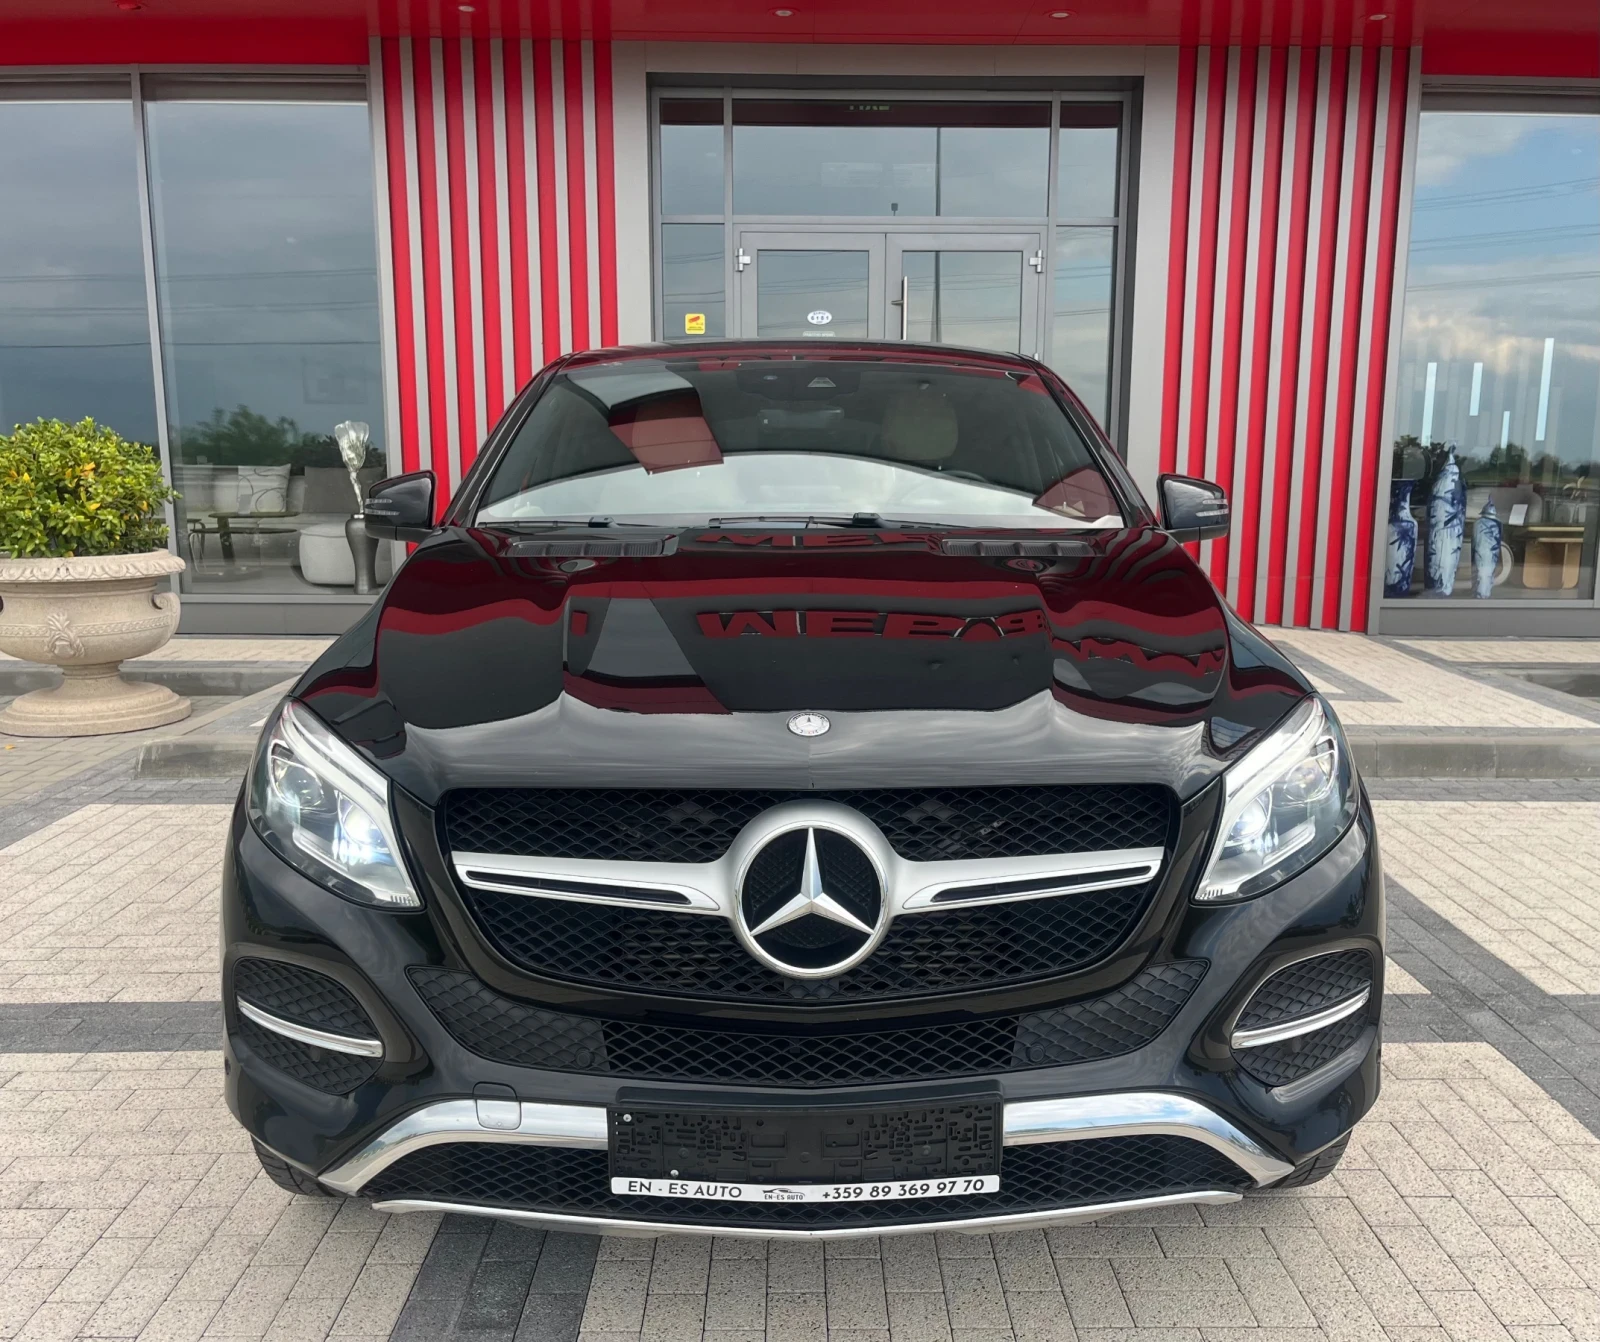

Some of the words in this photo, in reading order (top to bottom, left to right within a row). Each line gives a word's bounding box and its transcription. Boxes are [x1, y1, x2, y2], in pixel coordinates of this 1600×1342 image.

[628, 1180, 652, 1193] EN
[668, 1183, 689, 1195] ES
[693, 1185, 742, 1198] AUTO
[822, 1186, 863, 1199] +359
[869, 1185, 892, 1198] 89
[898, 1183, 930, 1196] 369
[936, 1181, 957, 1194] 97
[963, 1178, 984, 1192] 70
